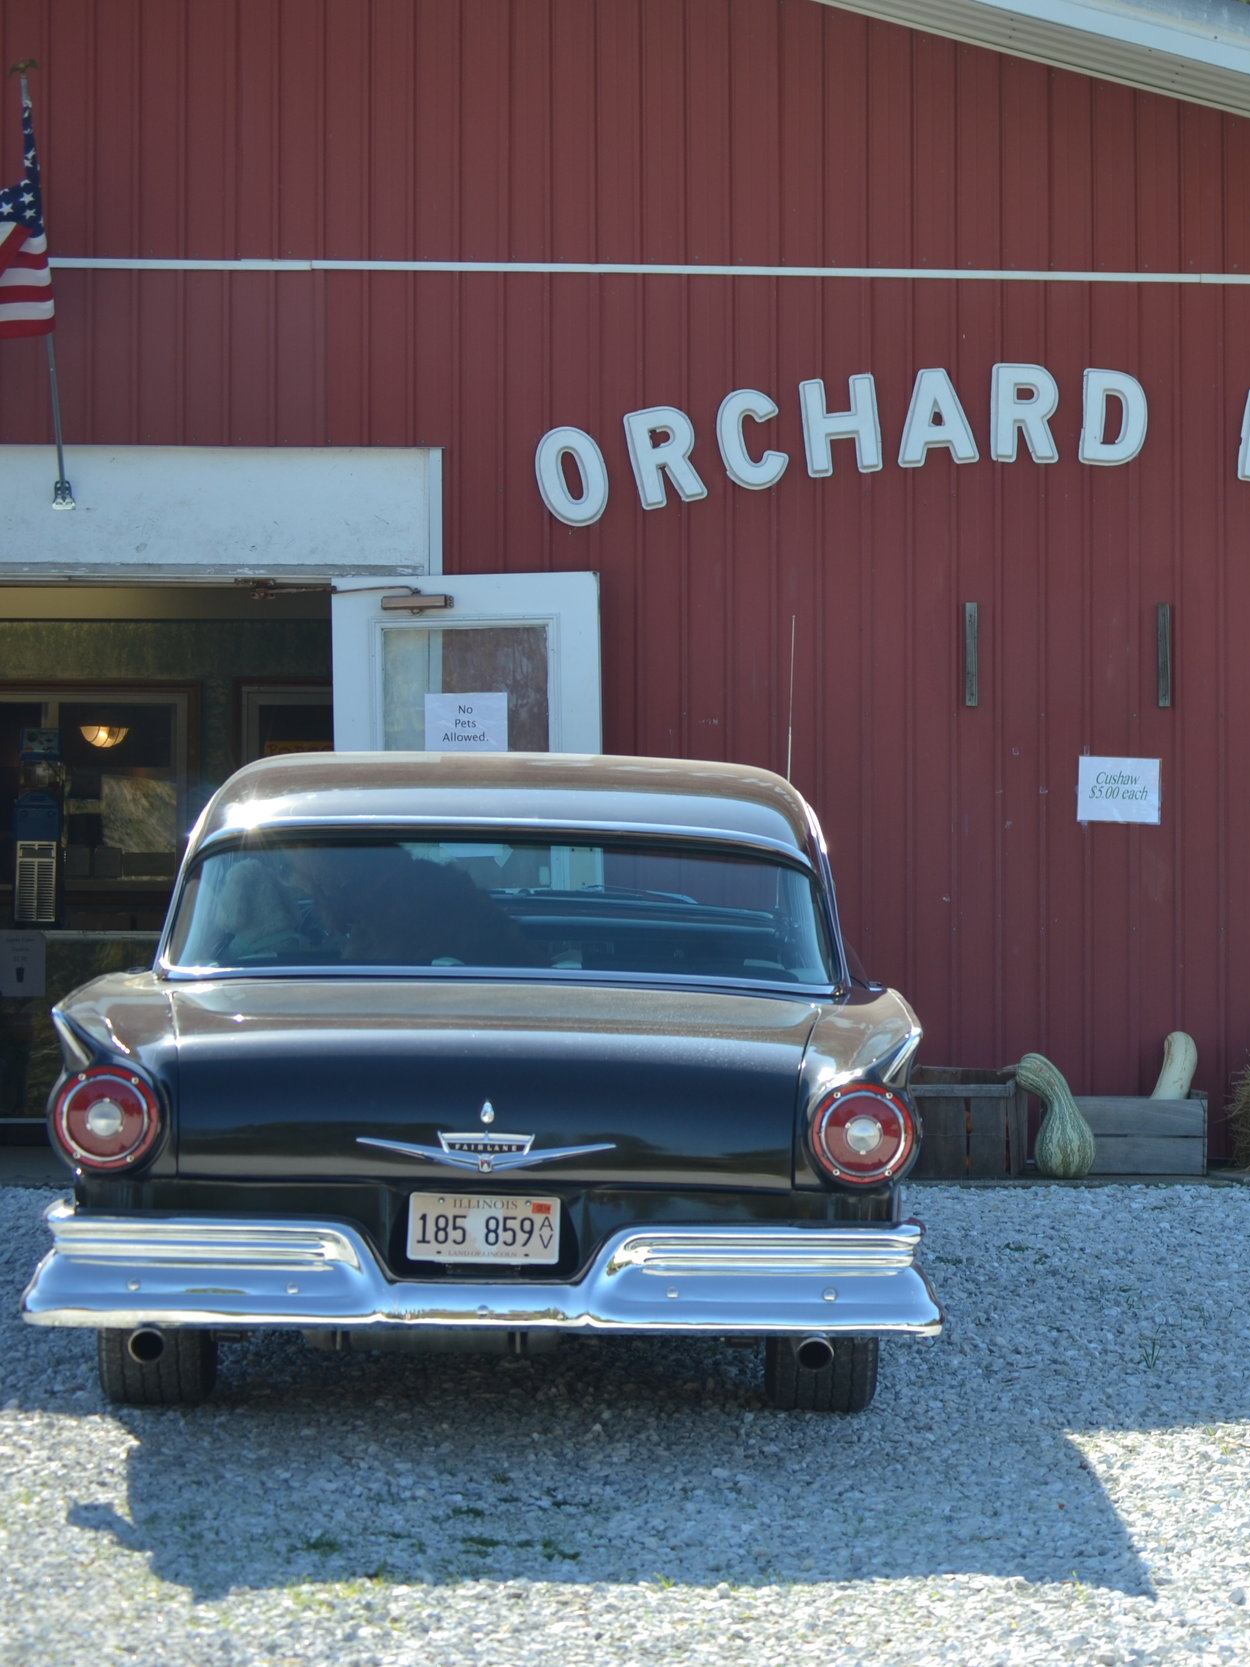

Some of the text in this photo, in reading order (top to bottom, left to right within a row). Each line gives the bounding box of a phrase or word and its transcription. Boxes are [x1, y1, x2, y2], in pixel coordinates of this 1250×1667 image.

[535, 362, 1148, 527] ORCHARD
[458, 704, 473, 714] No
[454, 718, 477, 728] Pets
[442, 731, 489, 742] Allowed.
[1096, 770, 1140, 785] Cushaw
[1089, 785, 1148, 800] $5.00 each
[454, 1143, 518, 1152] FAIRLANE
[453, 1198, 518, 1210] ILLINOIS
[416, 1213, 467, 1245] 185
[485, 1216, 535, 1247] 859
